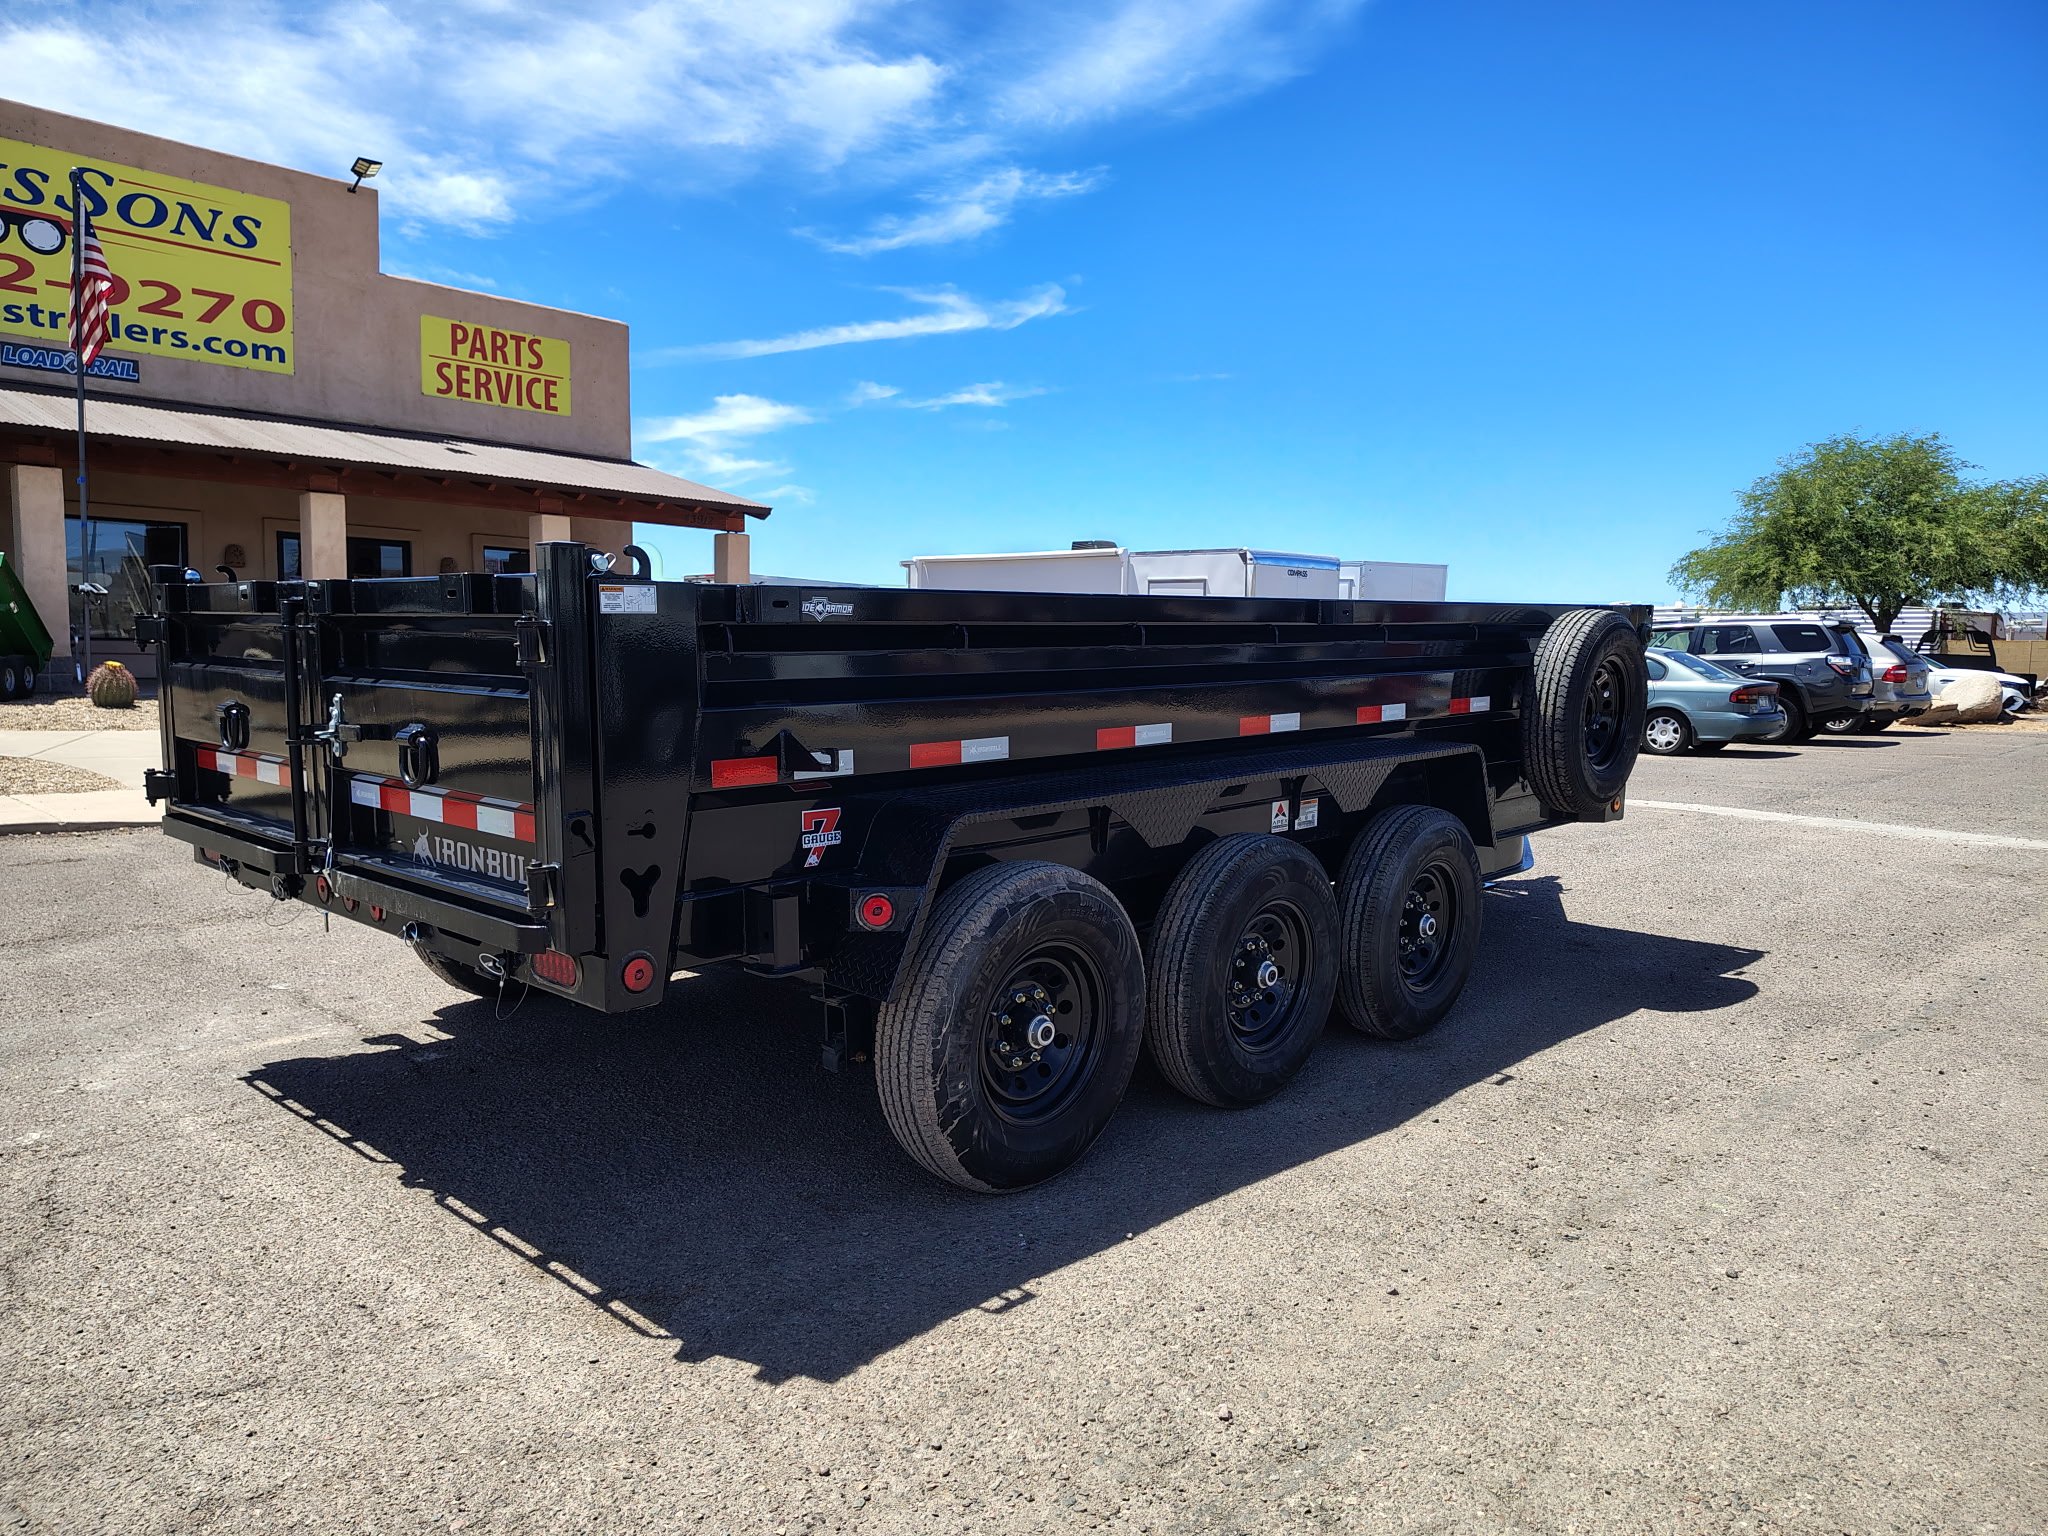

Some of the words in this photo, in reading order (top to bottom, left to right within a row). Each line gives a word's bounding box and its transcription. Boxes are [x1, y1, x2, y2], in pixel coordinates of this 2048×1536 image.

[54, 167, 262, 249] SONS
[3, 303, 286, 364] strlers.com
[450, 323, 543, 370] PARTS
[4, 345, 65, 370] LOAD
[83, 356, 139, 379] RAIL
[436, 362, 558, 412] SERVICE
[434, 836, 528, 885] IRONBUL
[803, 831, 841, 845] GAUGE
